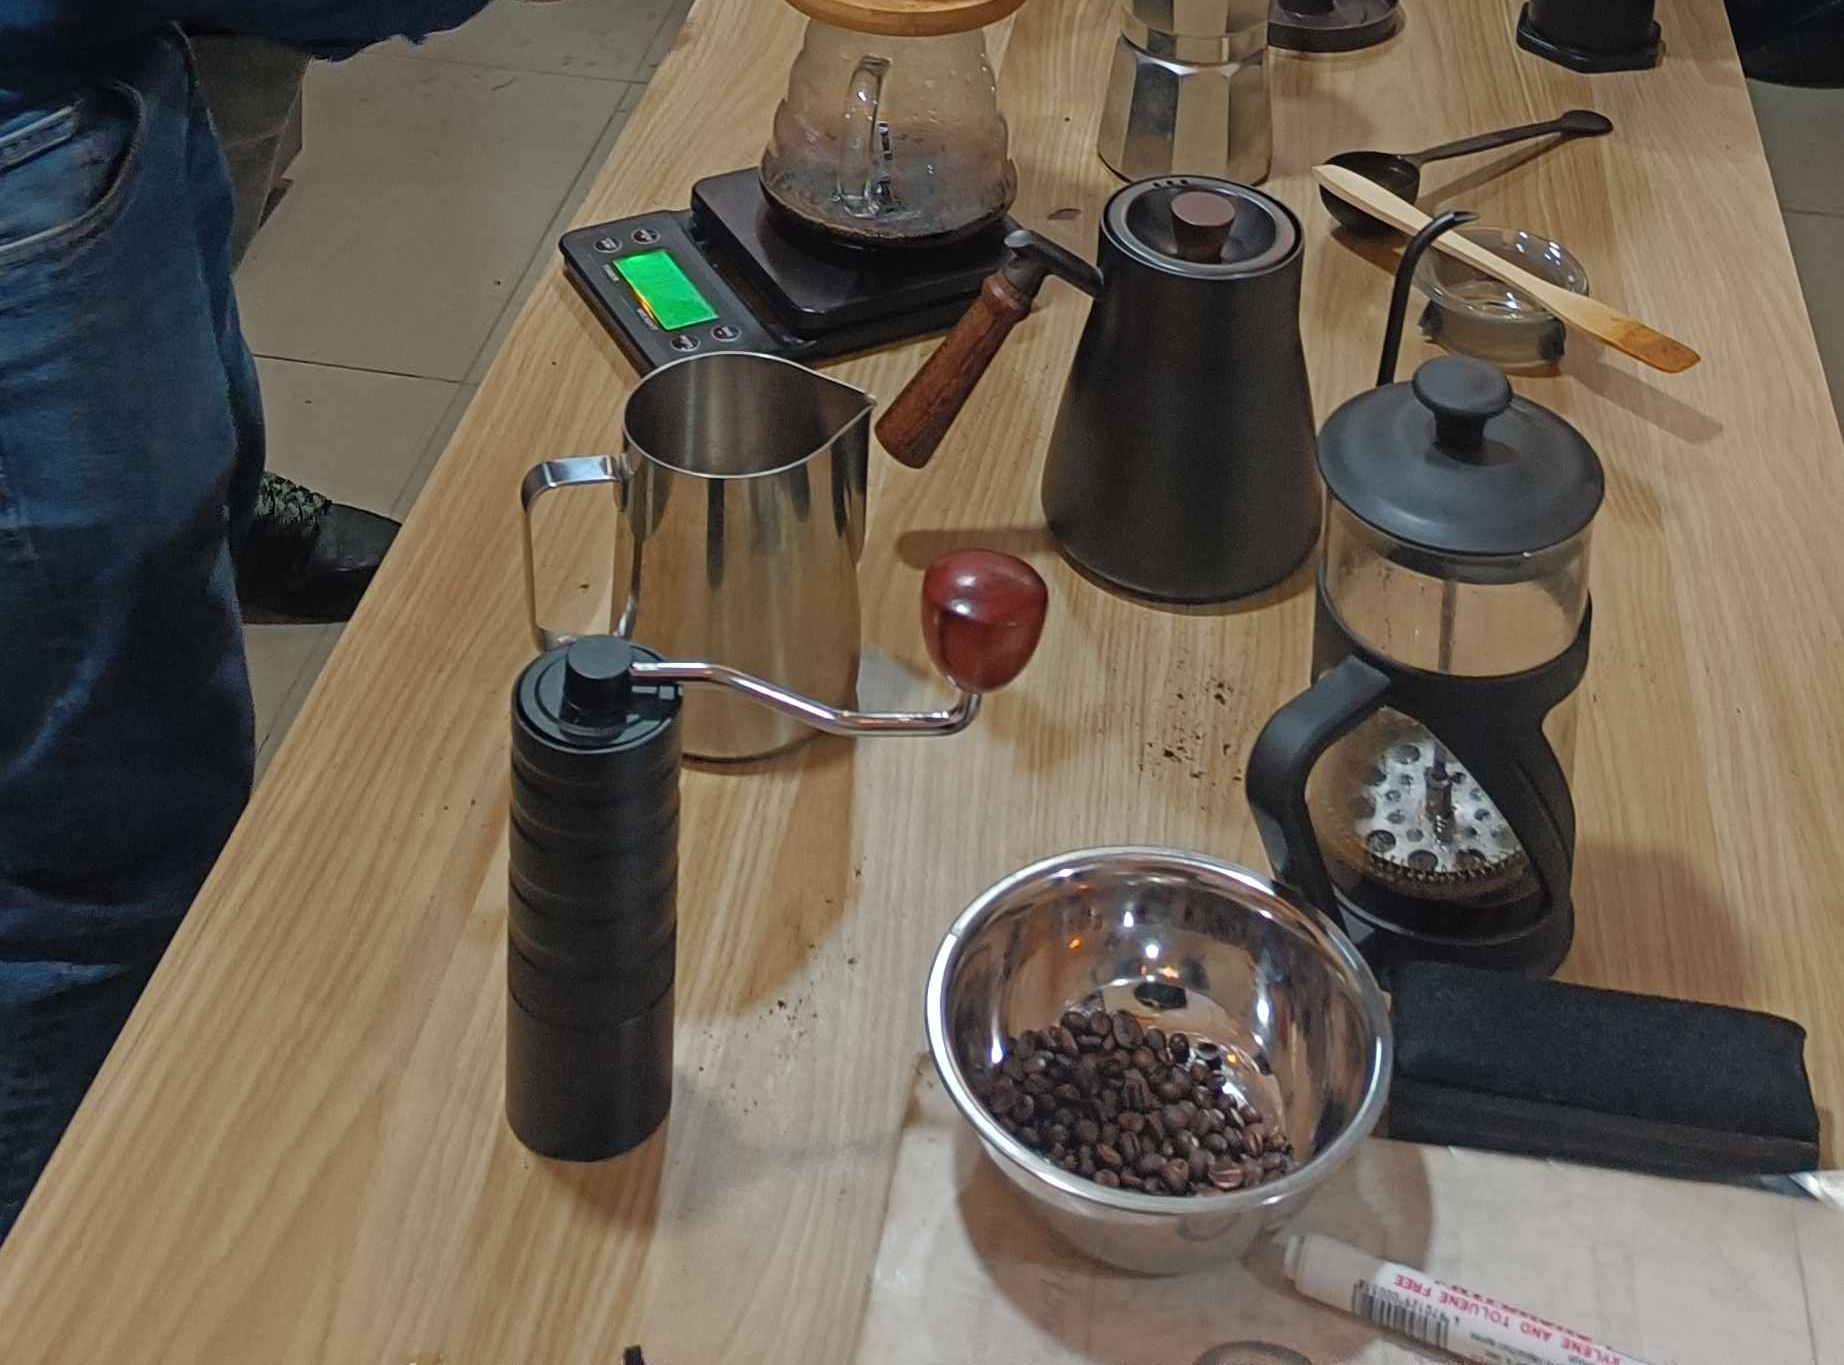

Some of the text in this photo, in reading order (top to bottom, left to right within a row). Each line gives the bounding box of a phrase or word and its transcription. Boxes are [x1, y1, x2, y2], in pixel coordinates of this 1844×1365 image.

[1393, 1273, 1431, 1298] FREE
[1439, 1293, 1509, 1328] TOLUENE
[1520, 1321, 1552, 1342] AND
